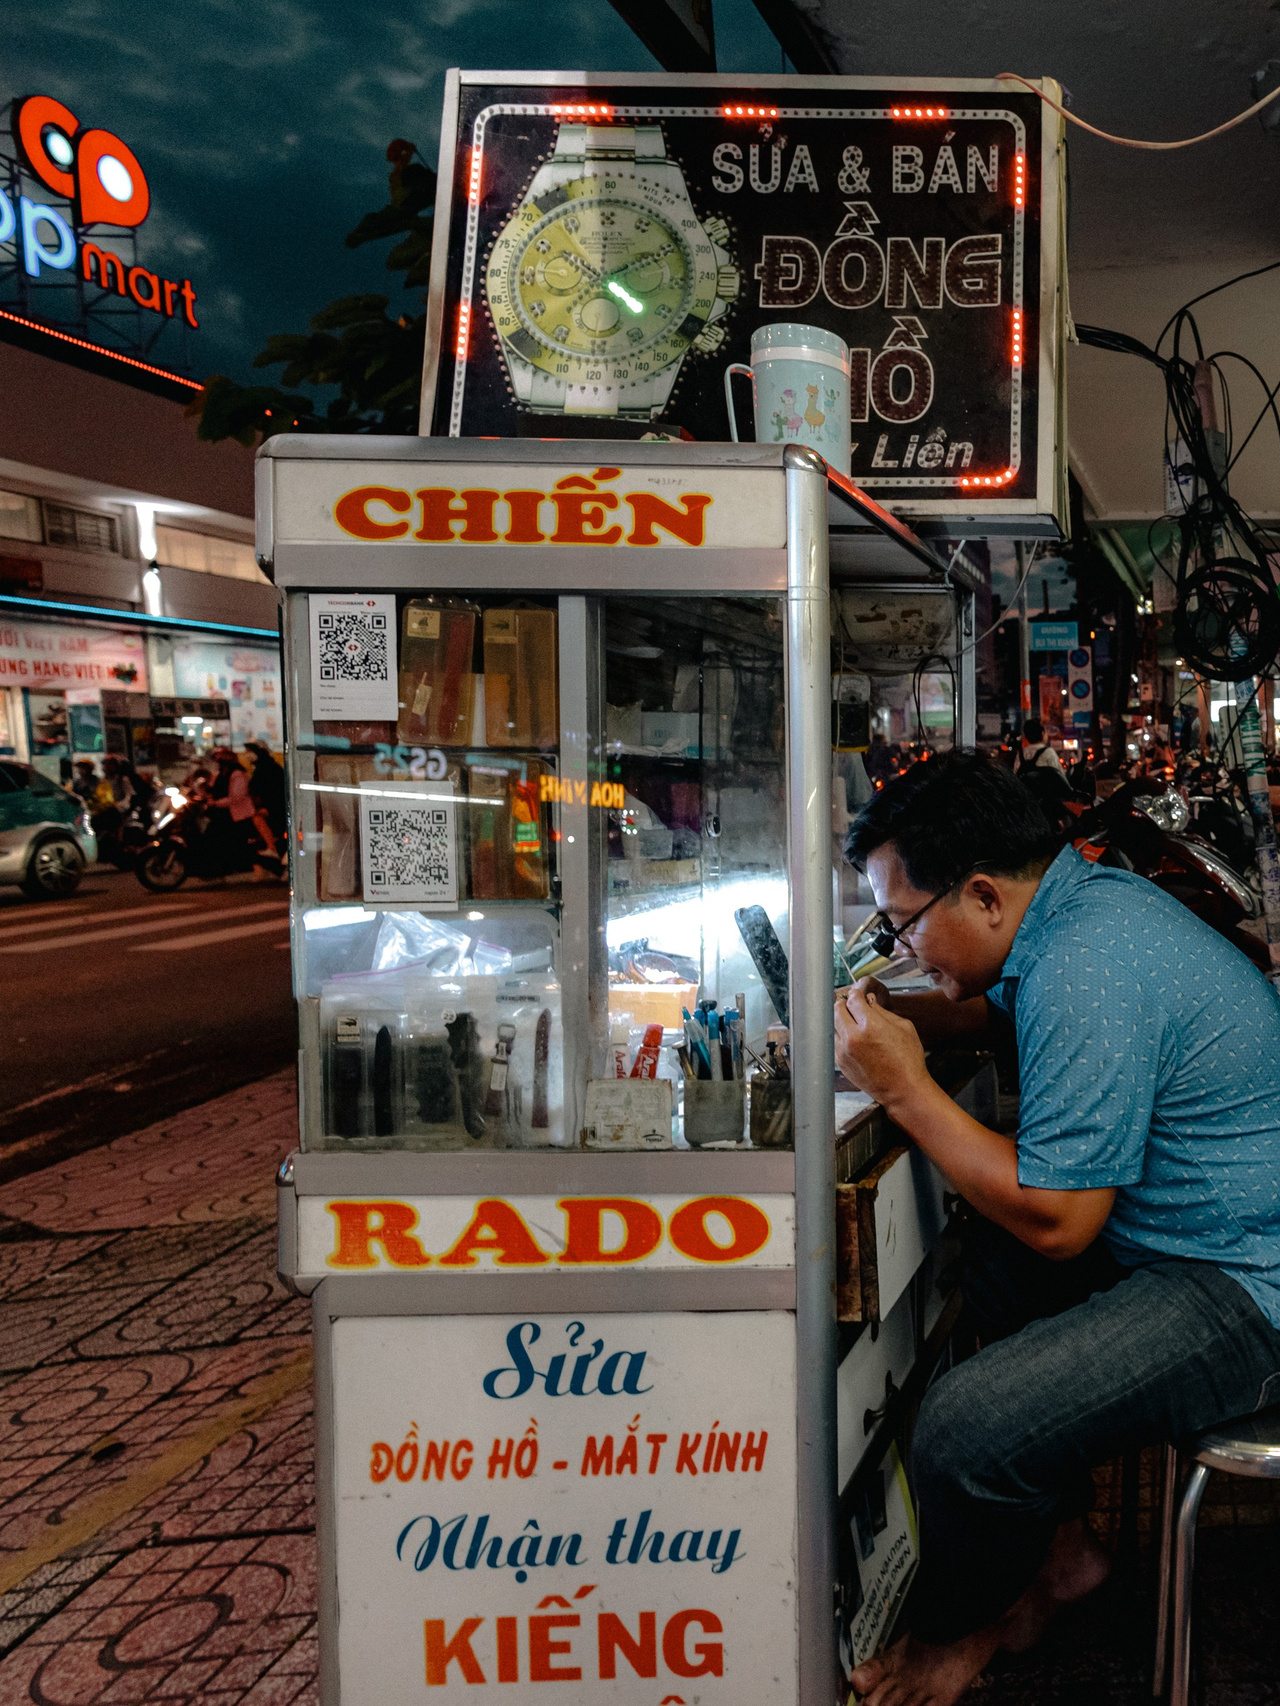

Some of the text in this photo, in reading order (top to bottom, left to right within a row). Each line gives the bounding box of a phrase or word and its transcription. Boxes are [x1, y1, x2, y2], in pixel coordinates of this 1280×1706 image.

[711, 122, 999, 194] SỬA & BÁN
[82, 242, 199, 329] mart
[754, 200, 1003, 309] ĐỒNG
[334, 466, 713, 548] CHIẾN
[325, 1195, 772, 1270] RADO
[483, 1320, 655, 1400] Sửa
[370, 1420, 474, 1484] ĐỒNG
[487, 1417, 541, 1480] HỒ
[580, 1414, 668, 1477] MẮT
[675, 1420, 770, 1476] KÍNH
[396, 1508, 747, 1583] Nhận thay
[423, 1584, 725, 1687] KIẾNG
